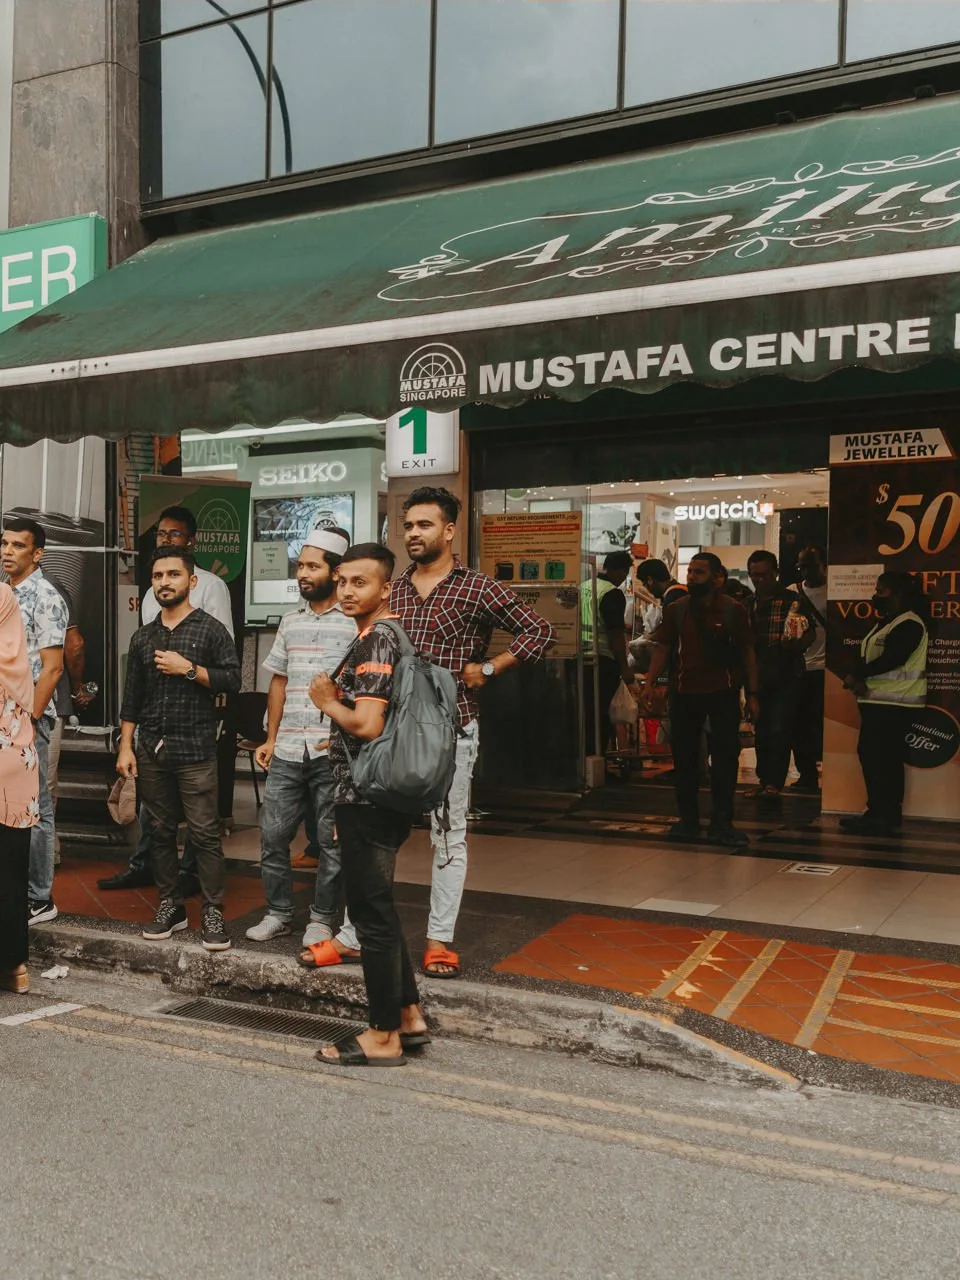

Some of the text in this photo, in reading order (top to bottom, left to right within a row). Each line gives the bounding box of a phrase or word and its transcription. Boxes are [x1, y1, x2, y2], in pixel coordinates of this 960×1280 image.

[621, 209, 925, 258] USA PARIS UK
[479, 343, 693, 395] MUSTAFA
[709, 317, 931, 371] CENTRE
[400, 376, 466, 392] MUSTAFA
[400, 387, 466, 402] SINGAPORE
[398, 406, 427, 455] 1
[845, 432, 924, 447] MUSTAFA
[844, 444, 939, 461] JEWELLERY
[402, 458, 437, 469] EXIT
[259, 461, 347, 486] SEIKO
[673, 499, 758, 521] swatch
[195, 532, 240, 543] MUSTAFA
[194, 545, 240, 553] SINGAPORE
[904, 733, 940, 751] Offer
